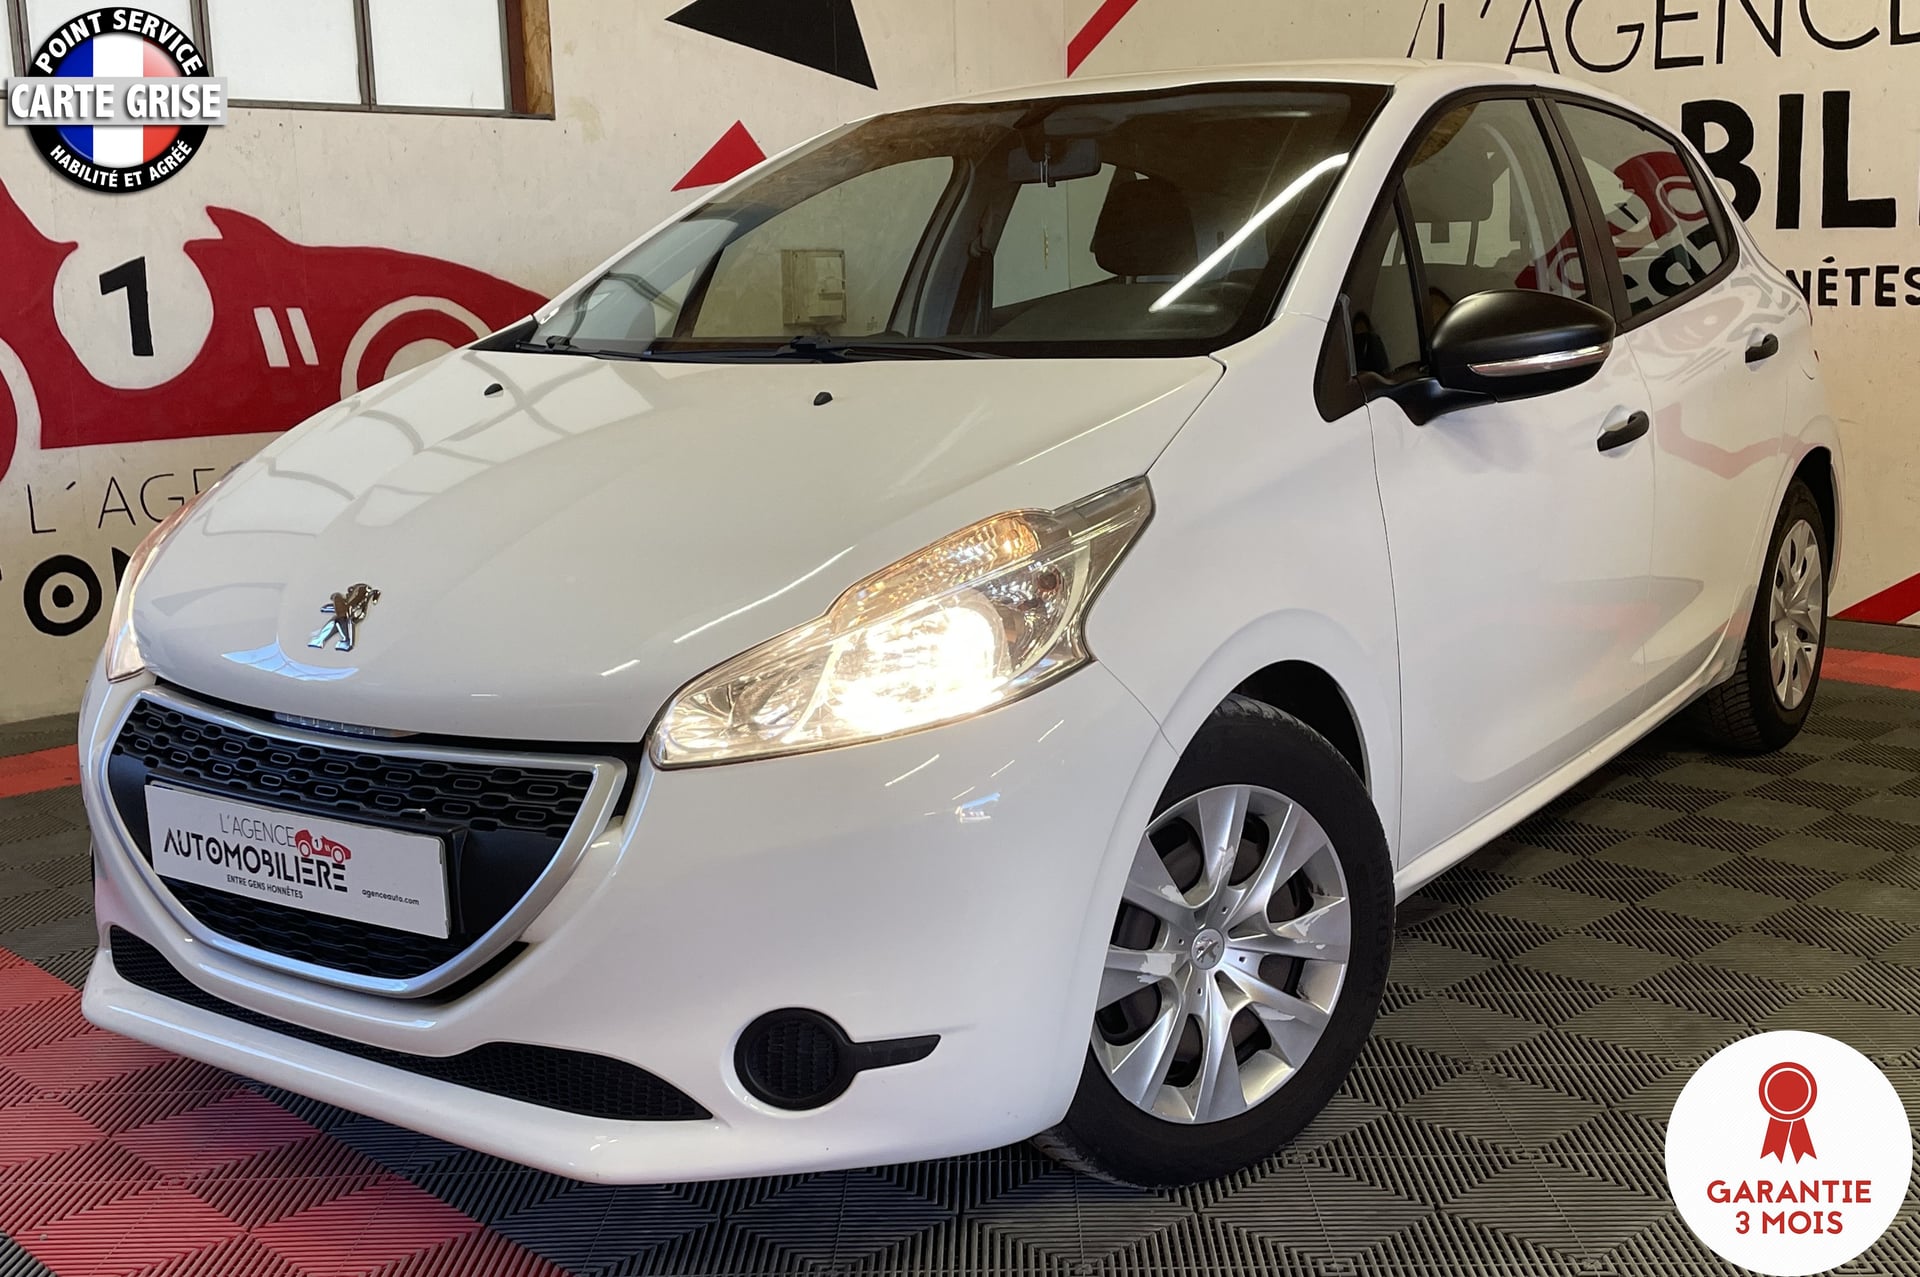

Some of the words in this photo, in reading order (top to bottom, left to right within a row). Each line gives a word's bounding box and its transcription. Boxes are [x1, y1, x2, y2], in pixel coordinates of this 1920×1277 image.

[99, 256, 154, 356] 1
[219, 812, 297, 848] L'AGENCE
[226, 874, 247, 886] ENTRE
[248, 879, 266, 890] GENS
[361, 889, 420, 905] agenceauto.com
